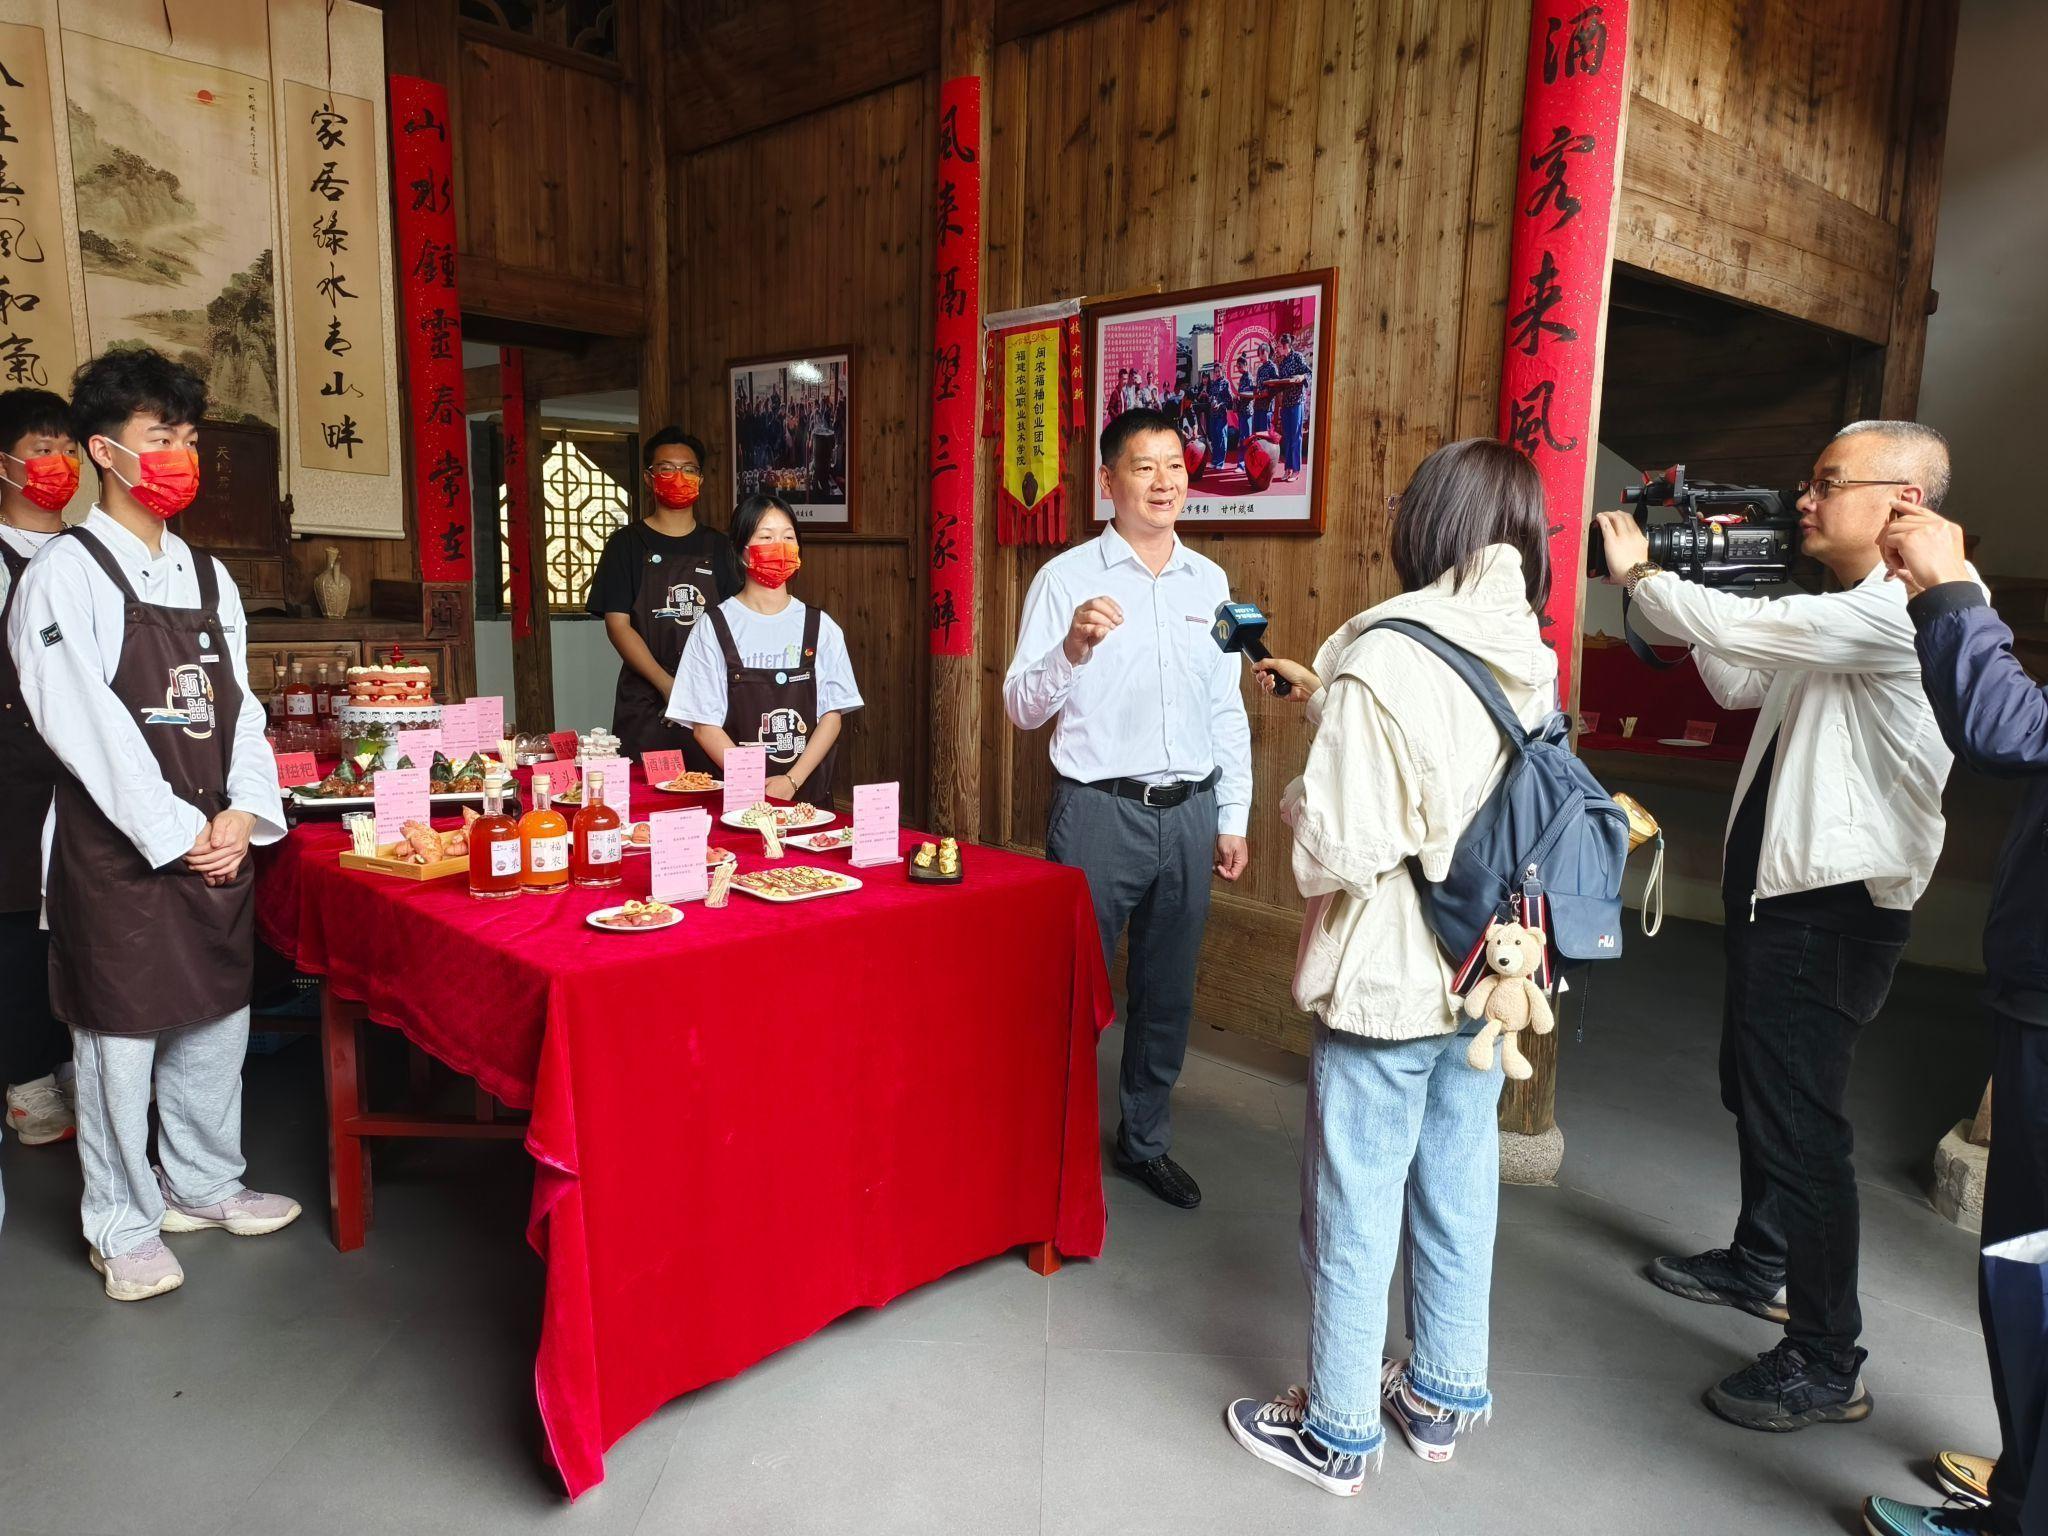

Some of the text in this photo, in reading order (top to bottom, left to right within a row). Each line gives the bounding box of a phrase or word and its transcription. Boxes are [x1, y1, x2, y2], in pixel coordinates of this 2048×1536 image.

[1015, 350, 1027, 467] 福建农业职业技术学院
